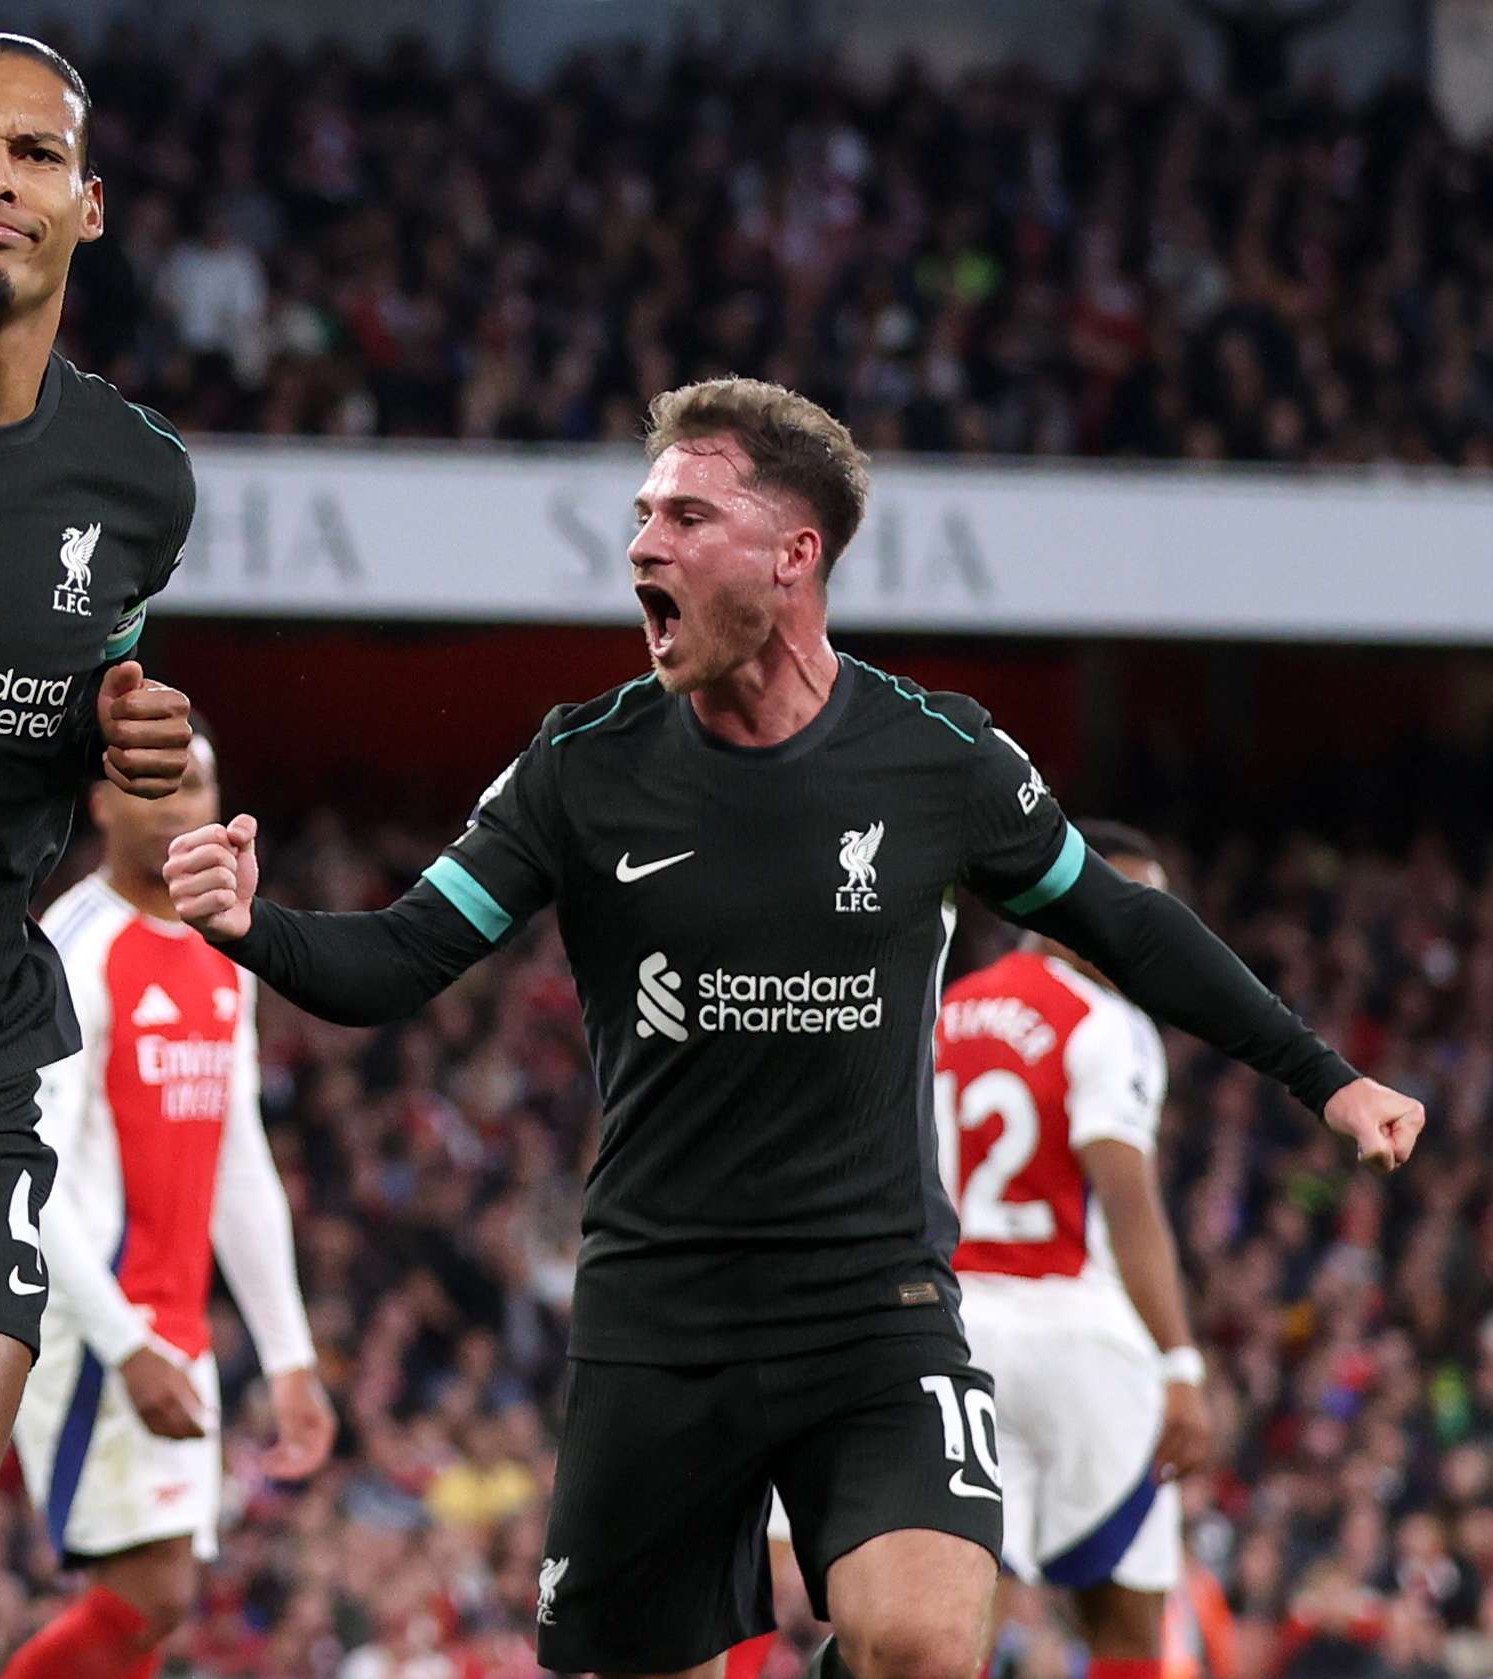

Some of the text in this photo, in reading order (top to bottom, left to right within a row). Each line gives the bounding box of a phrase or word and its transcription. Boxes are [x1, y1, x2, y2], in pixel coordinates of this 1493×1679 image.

[698, 967, 876, 1001] standard
[698, 998, 882, 1033] chartered
[934, 1068, 1057, 1242] 12
[919, 1375, 1002, 1488] 10
